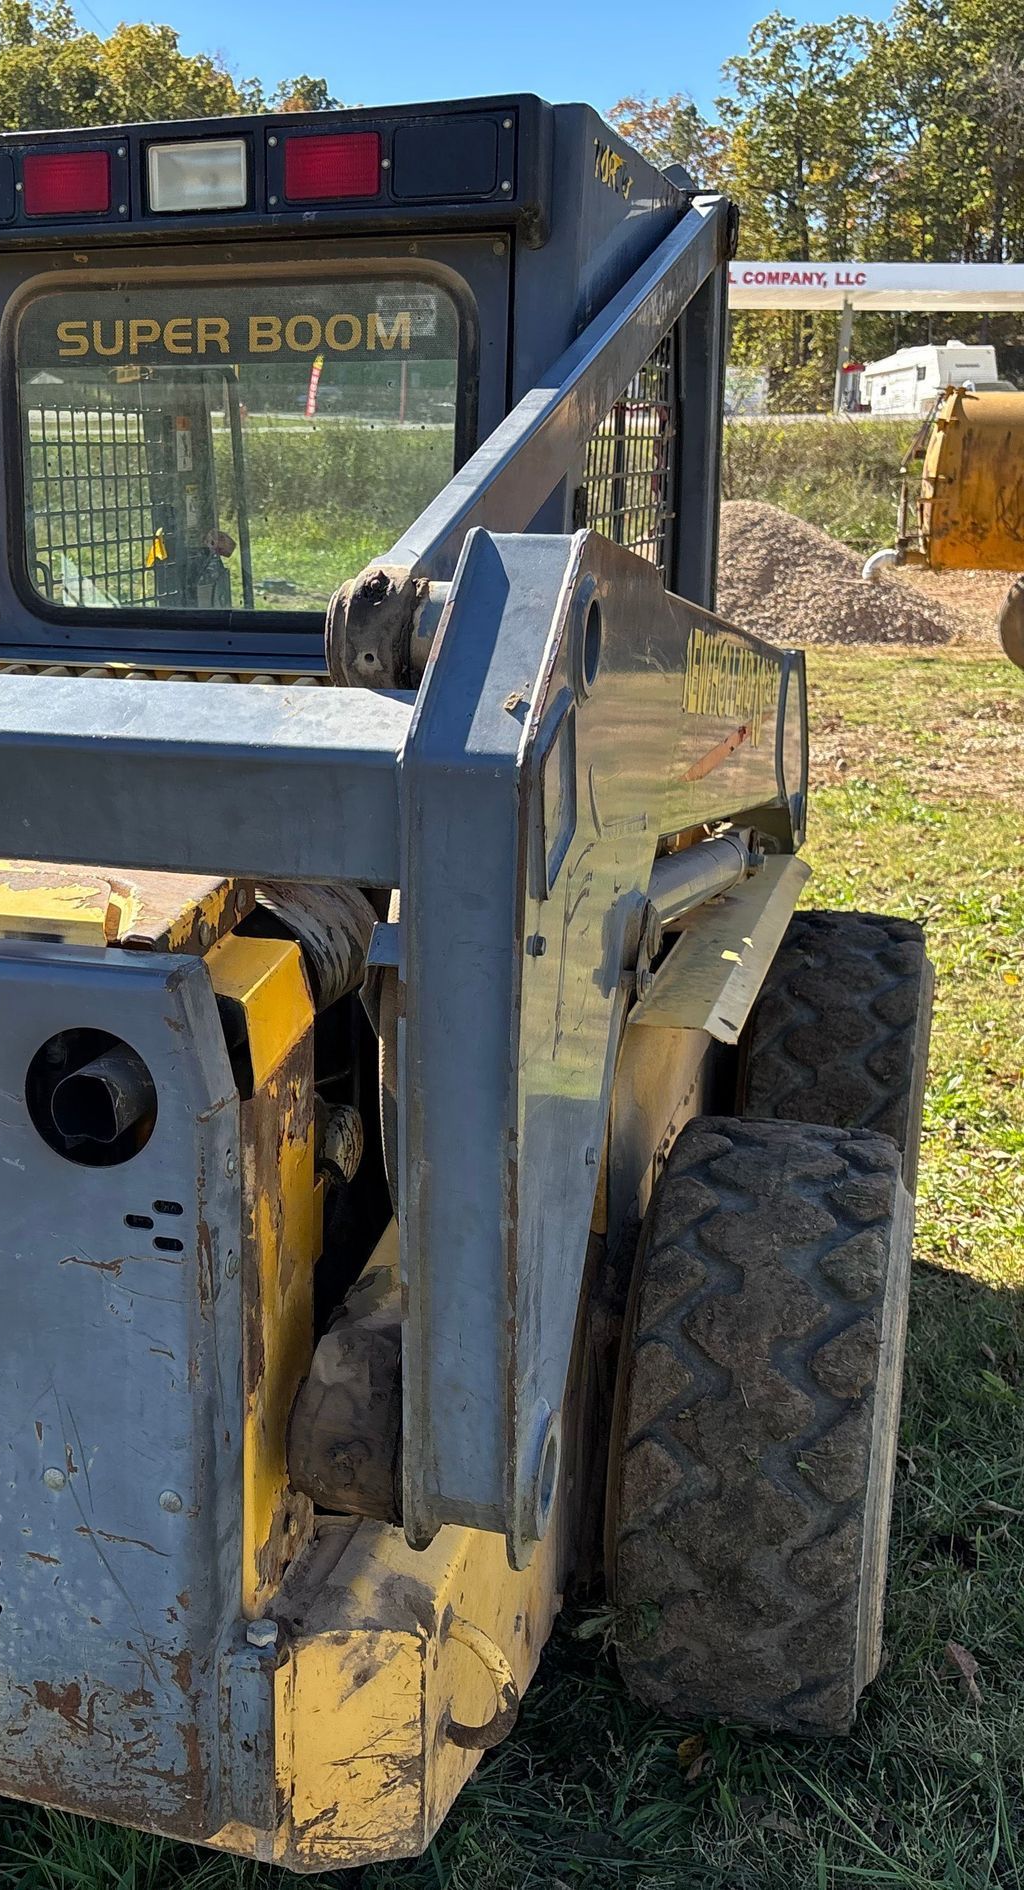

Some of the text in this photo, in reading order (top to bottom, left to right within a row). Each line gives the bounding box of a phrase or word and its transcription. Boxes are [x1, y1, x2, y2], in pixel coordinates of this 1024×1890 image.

[743, 272, 827, 288] COMPANY,
[836, 273, 867, 285] LLC
[57, 312, 411, 356] SUPER BOOM
